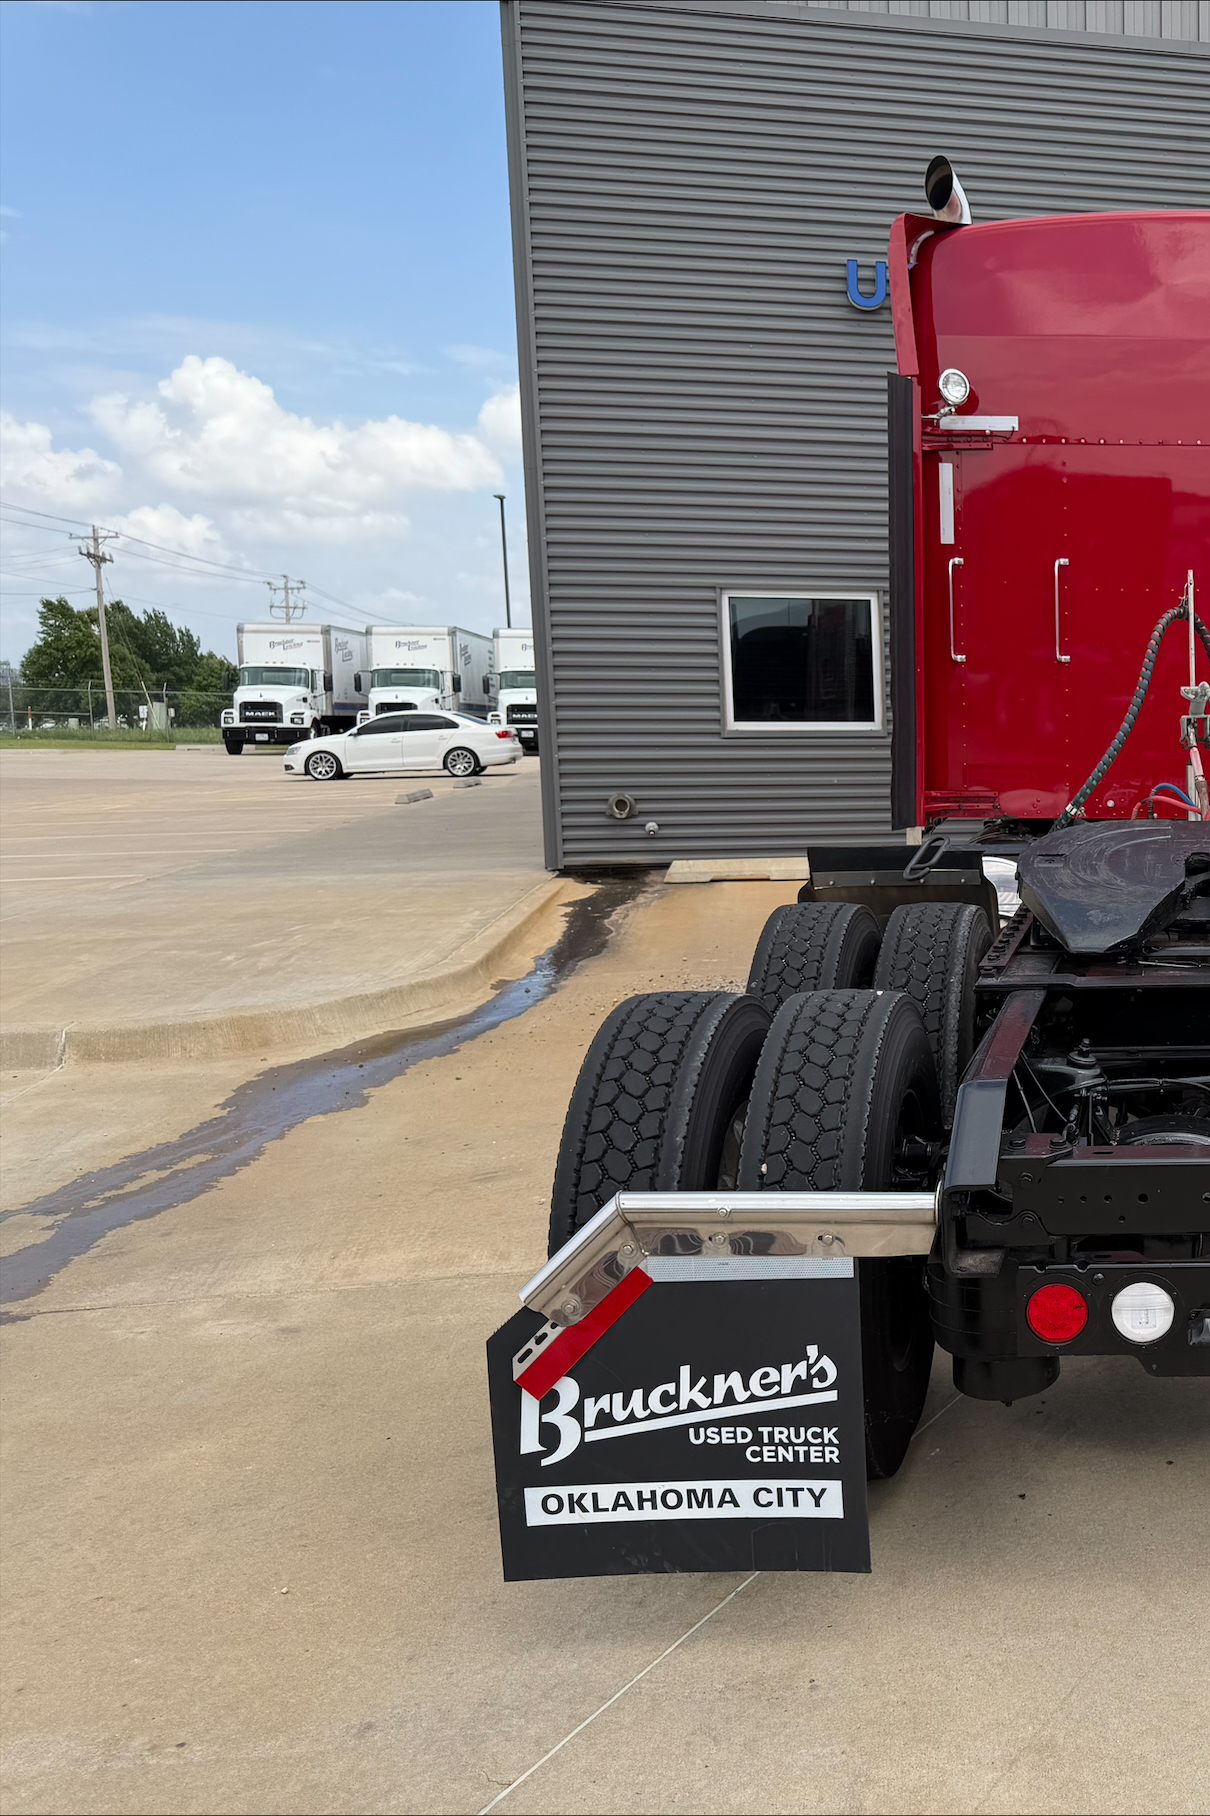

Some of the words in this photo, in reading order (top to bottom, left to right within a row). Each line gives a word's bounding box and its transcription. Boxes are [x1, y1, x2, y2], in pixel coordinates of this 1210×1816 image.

[519, 1344, 838, 1466] Bruckner's
[688, 1426, 752, 1445] USED
[761, 1426, 839, 1444] TRUCK
[745, 1446, 840, 1464] CENTER
[540, 1487, 740, 1516] OKLAHOMA
[752, 1487, 828, 1508] CITY
